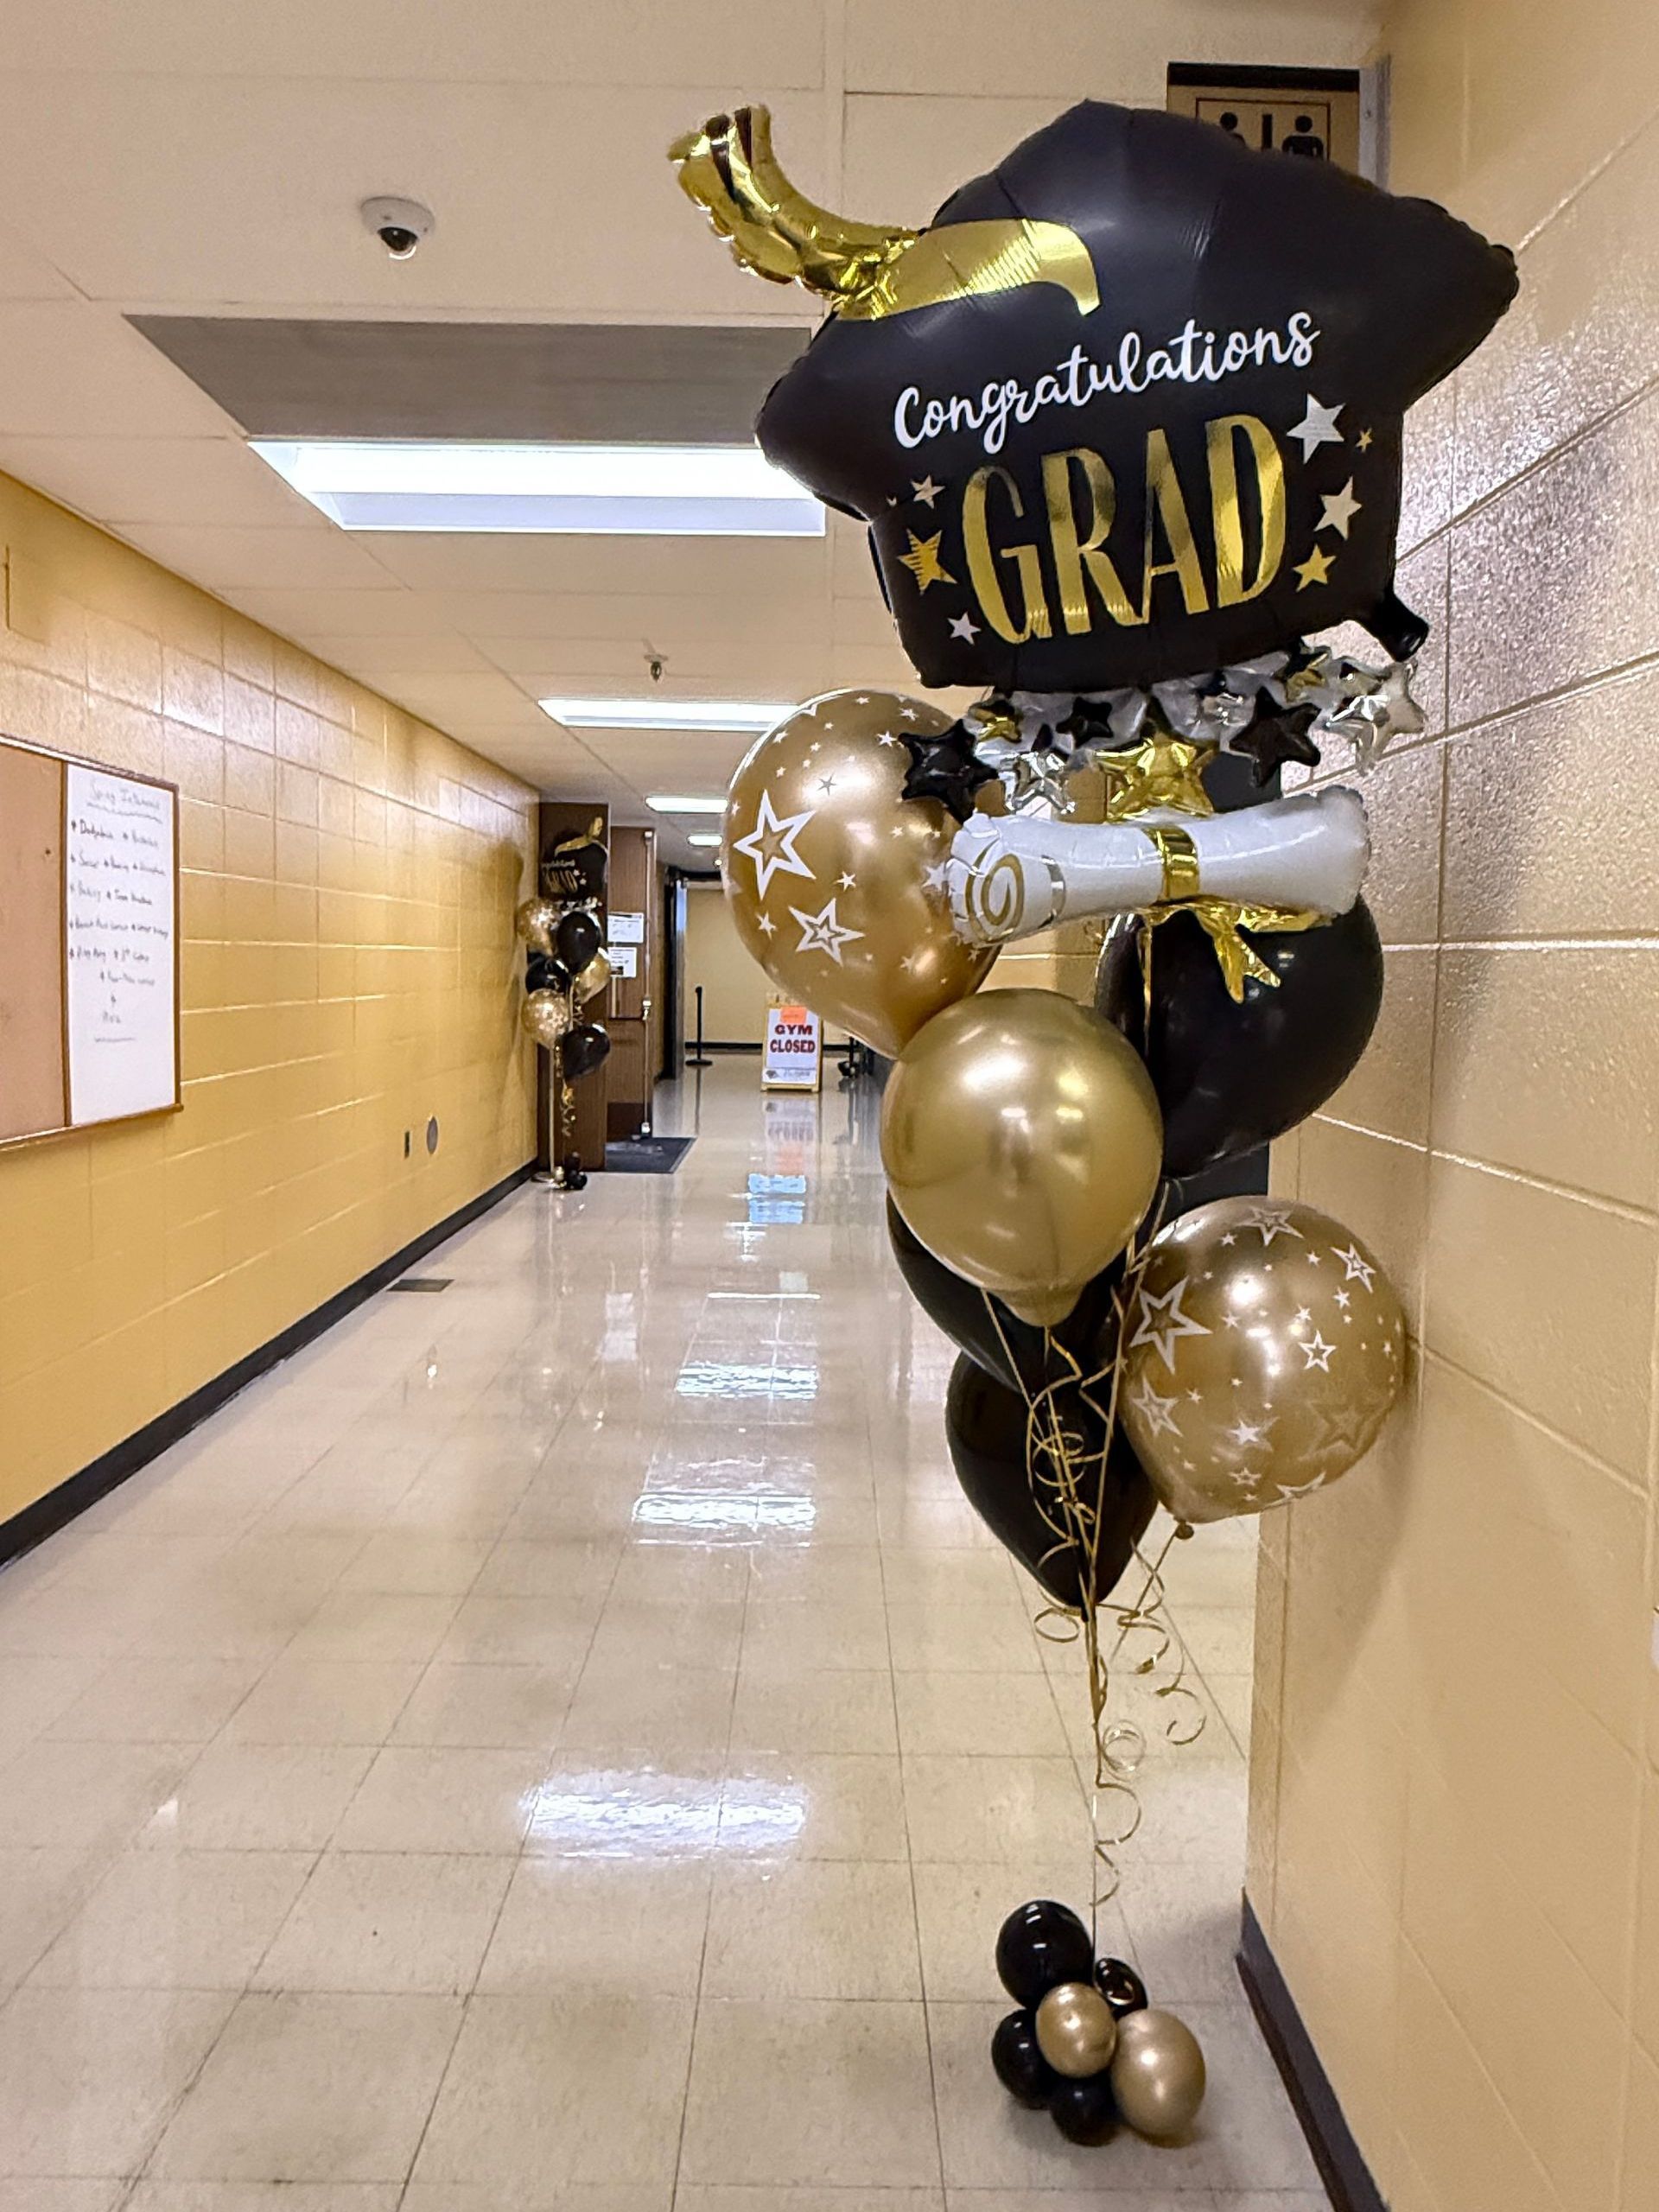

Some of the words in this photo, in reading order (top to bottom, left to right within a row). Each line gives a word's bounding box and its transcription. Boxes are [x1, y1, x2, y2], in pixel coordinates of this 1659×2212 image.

[894, 312, 1321, 454] Congratulations
[963, 414, 1287, 645] GRAD
[770, 1039, 816, 1053] CLOSED
[774, 1025, 813, 1035] GYM
